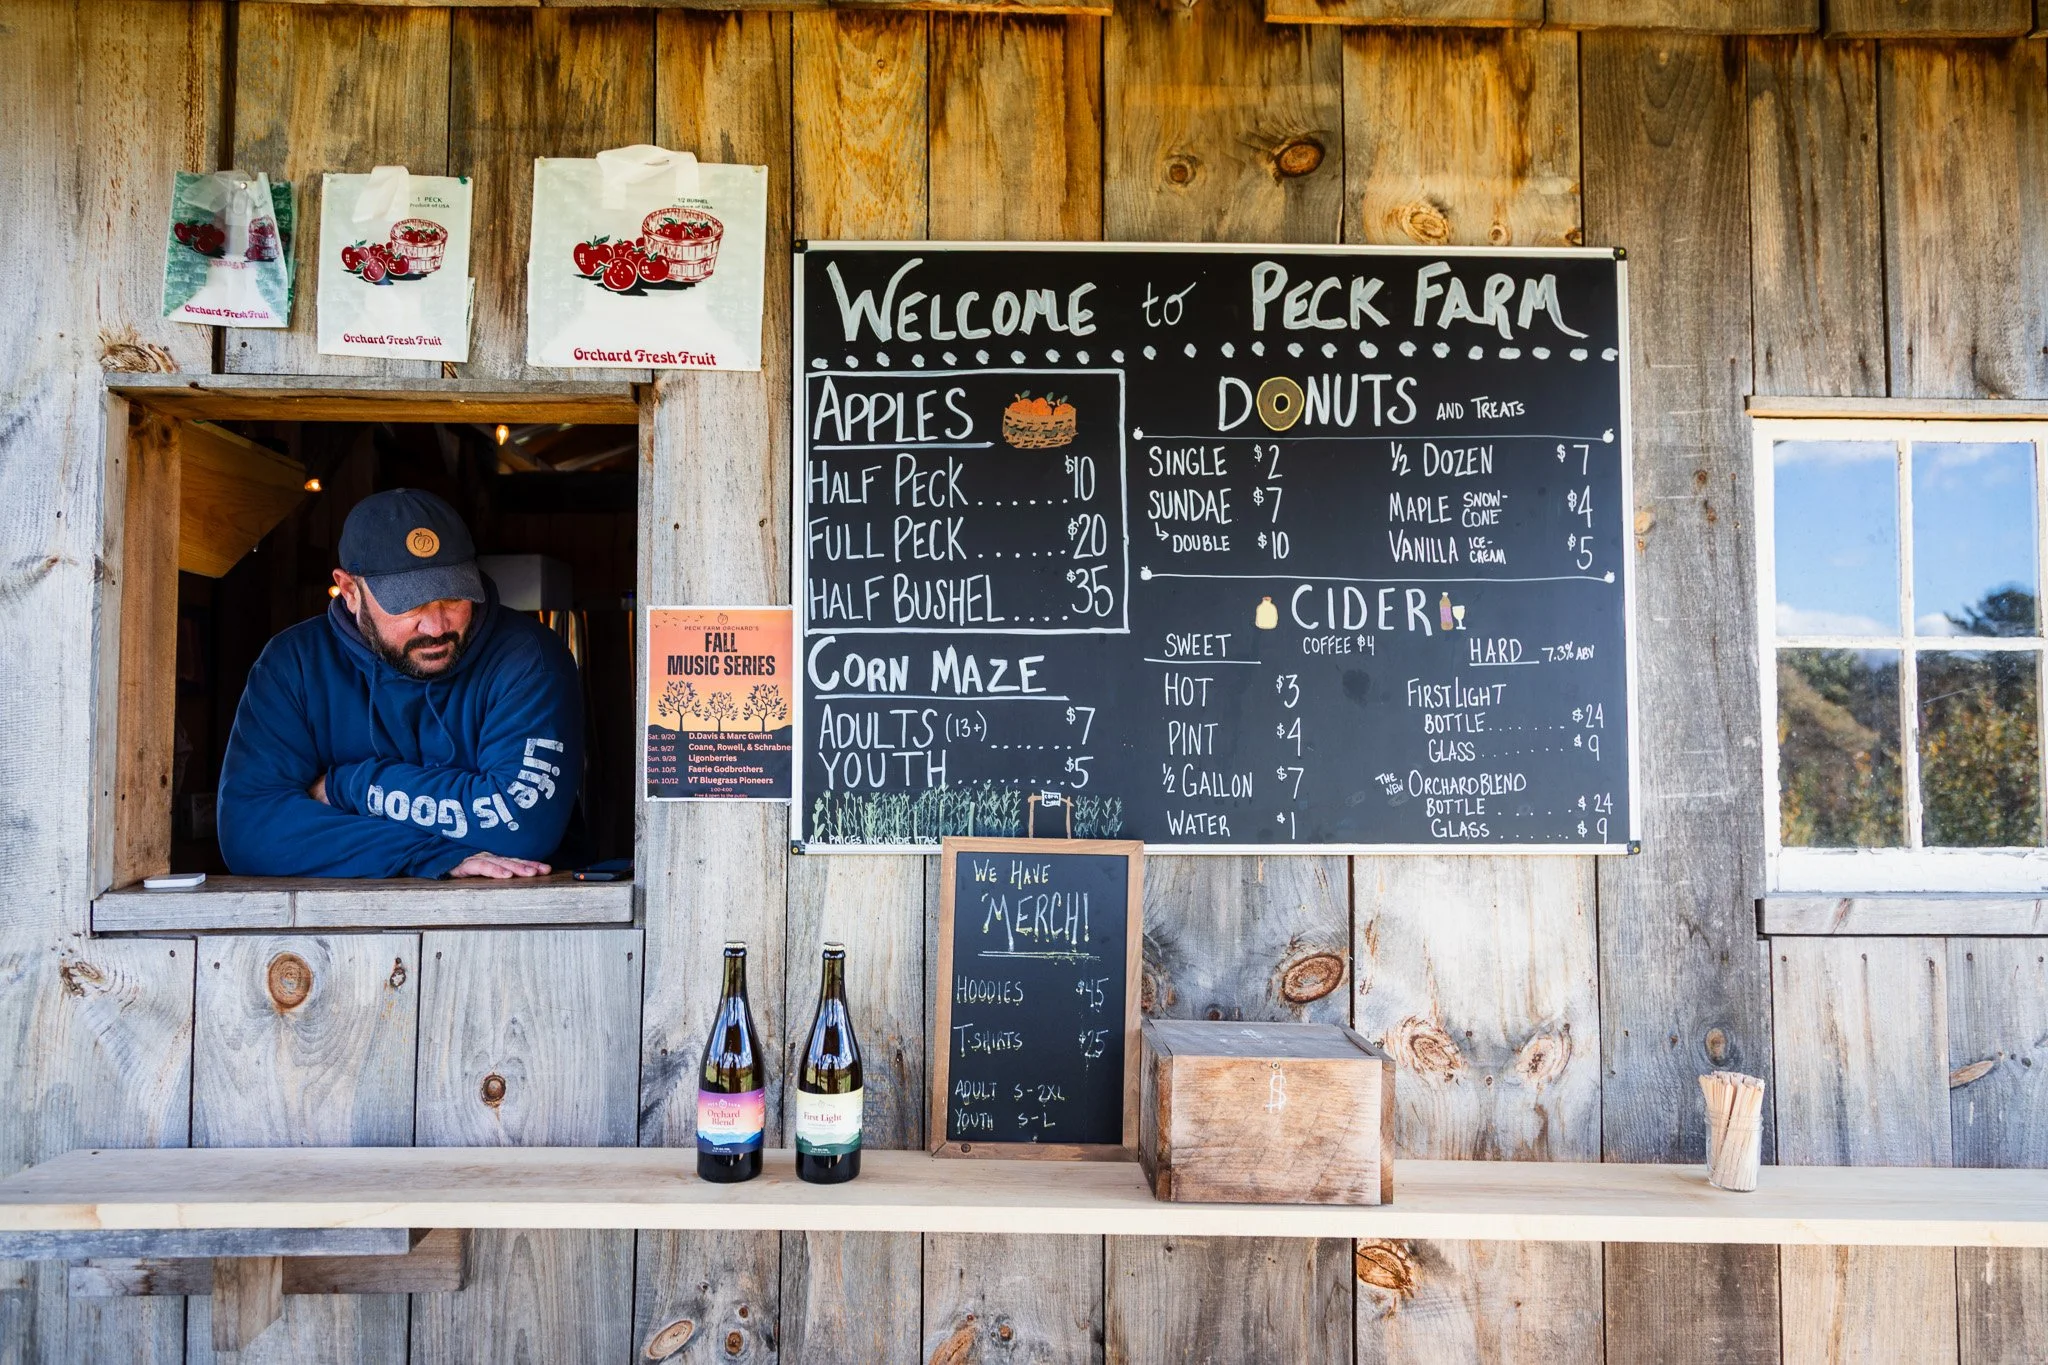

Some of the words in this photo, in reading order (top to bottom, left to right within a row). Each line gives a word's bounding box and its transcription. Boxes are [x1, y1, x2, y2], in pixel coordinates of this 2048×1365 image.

[184, 304, 222, 317] Orchard
[223, 308, 248, 320] Fresh
[248, 310, 269, 320] Fruit
[827, 258, 1096, 342] WELCOME
[1142, 282, 1196, 327] to
[1252, 261, 1390, 331] PECK
[1414, 262, 1588, 340] FARM
[343, 333, 385, 346] Orchard
[386, 335, 416, 346] Fresh
[416, 335, 442, 347] Fruit
[573, 347, 632, 363] Orchard
[634, 349, 677, 364] Fresh
[678, 350, 717, 366] Fruit
[813, 376, 973, 442] APPLES
[1437, 403, 1463, 420] AND
[1471, 396, 1525, 418] TREATS
[1149, 446, 1227, 476] SINGLE
[1424, 443, 1492, 477] DOZEN
[808, 459, 882, 504] HALF
[896, 453, 968, 508] PECK
[1065, 455, 1095, 501] $10
[1148, 488, 1232, 524] SUNDAE
[1390, 492, 1452, 523] MAPLE
[1462, 508, 1502, 527] CONE
[809, 517, 884, 561] FULL
[895, 516, 966, 563] PECK
[1068, 514, 1106, 559] $20
[1173, 535, 1230, 553] DOUBLE
[1389, 529, 1459, 564] VANILLA
[1469, 549, 1506, 564] CREAM
[809, 575, 884, 621] HALF
[894, 573, 1005, 626] BUSHEL
[1067, 565, 1113, 617] $35
[1292, 584, 1432, 636] CIDER
[704, 632, 738, 653] FALL
[1165, 633, 1231, 657] SWEET
[1303, 635, 1351, 655] COFFEE
[1357, 634, 1374, 656] $4
[1470, 637, 1522, 662] HARD
[1575, 644, 1596, 661] ABV
[667, 655, 719, 676] MUSIC
[723, 655, 776, 676] SERIES
[808, 636, 909, 693] CORN
[931, 645, 1046, 695] MAZE
[1165, 673, 1213, 707] HOT
[1276, 674, 1300, 708] $3
[819, 704, 938, 749] ADULTS
[946, 710, 986, 742] (13+)
[1066, 706, 1095, 745] $7
[1424, 712, 1486, 734] BOTTLE
[661, 733, 676, 741] 9/20
[688, 743, 716, 752] Coane,
[717, 743, 746, 752] Rowell,
[746, 743, 753, 751] &
[719, 732, 726, 740] &
[726, 732, 746, 740] Marc
[747, 732, 773, 740] Gwinn
[1169, 721, 1218, 756] PINT
[1277, 717, 1301, 756] $4
[688, 754, 738, 763] Ligonberries
[1428, 739, 1476, 763] GLASS
[508, 737, 565, 809] Life
[688, 765, 712, 773] Faerie
[713, 765, 764, 773] Godbrothers
[688, 776, 699, 784] VT
[700, 776, 738, 785] Bluegrass
[739, 776, 774, 784] Pioneers
[819, 750, 947, 790] YOUTH
[1065, 756, 1093, 788] $5
[1183, 763, 1252, 798] GALLON
[1276, 766, 1304, 799] $7
[1375, 773, 1397, 785] THE
[1426, 797, 1485, 818] BOTTLE
[1167, 810, 1230, 837] WATER
[1431, 818, 1491, 840] GLASS
[829, 835, 862, 845] PRICES
[867, 835, 911, 845] INCLUDE
[973, 859, 998, 883] WE
[1010, 860, 1051, 890] HAVE
[980, 892, 1090, 952] MERCH!
[957, 975, 1023, 1006] HOODIES
[955, 1080, 996, 1105] ADULT
[707, 1109, 741, 1118] Orchard
[803, 1112, 819, 1121] First
[820, 1112, 842, 1124] Light
[955, 1108, 993, 1134] YOUTH
